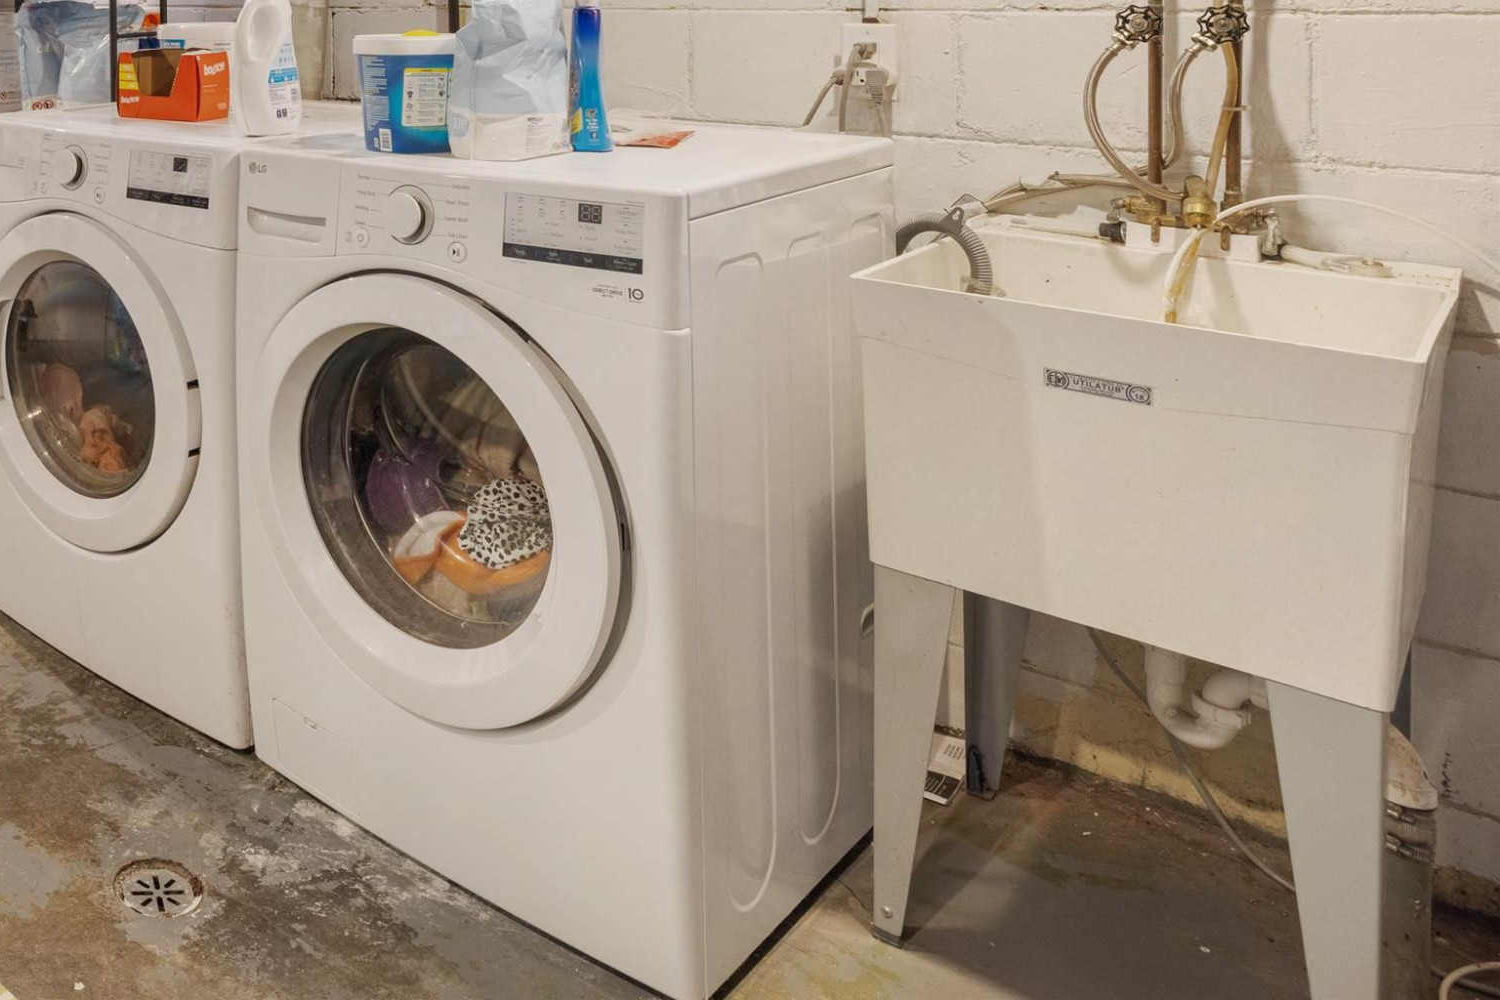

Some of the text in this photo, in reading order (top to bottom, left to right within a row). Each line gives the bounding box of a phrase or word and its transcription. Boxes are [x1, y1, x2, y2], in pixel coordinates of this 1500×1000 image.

[203, 61, 225, 76] bounce
[627, 287, 644, 301] 10
[1072, 379, 1121, 393] UTILATUB
